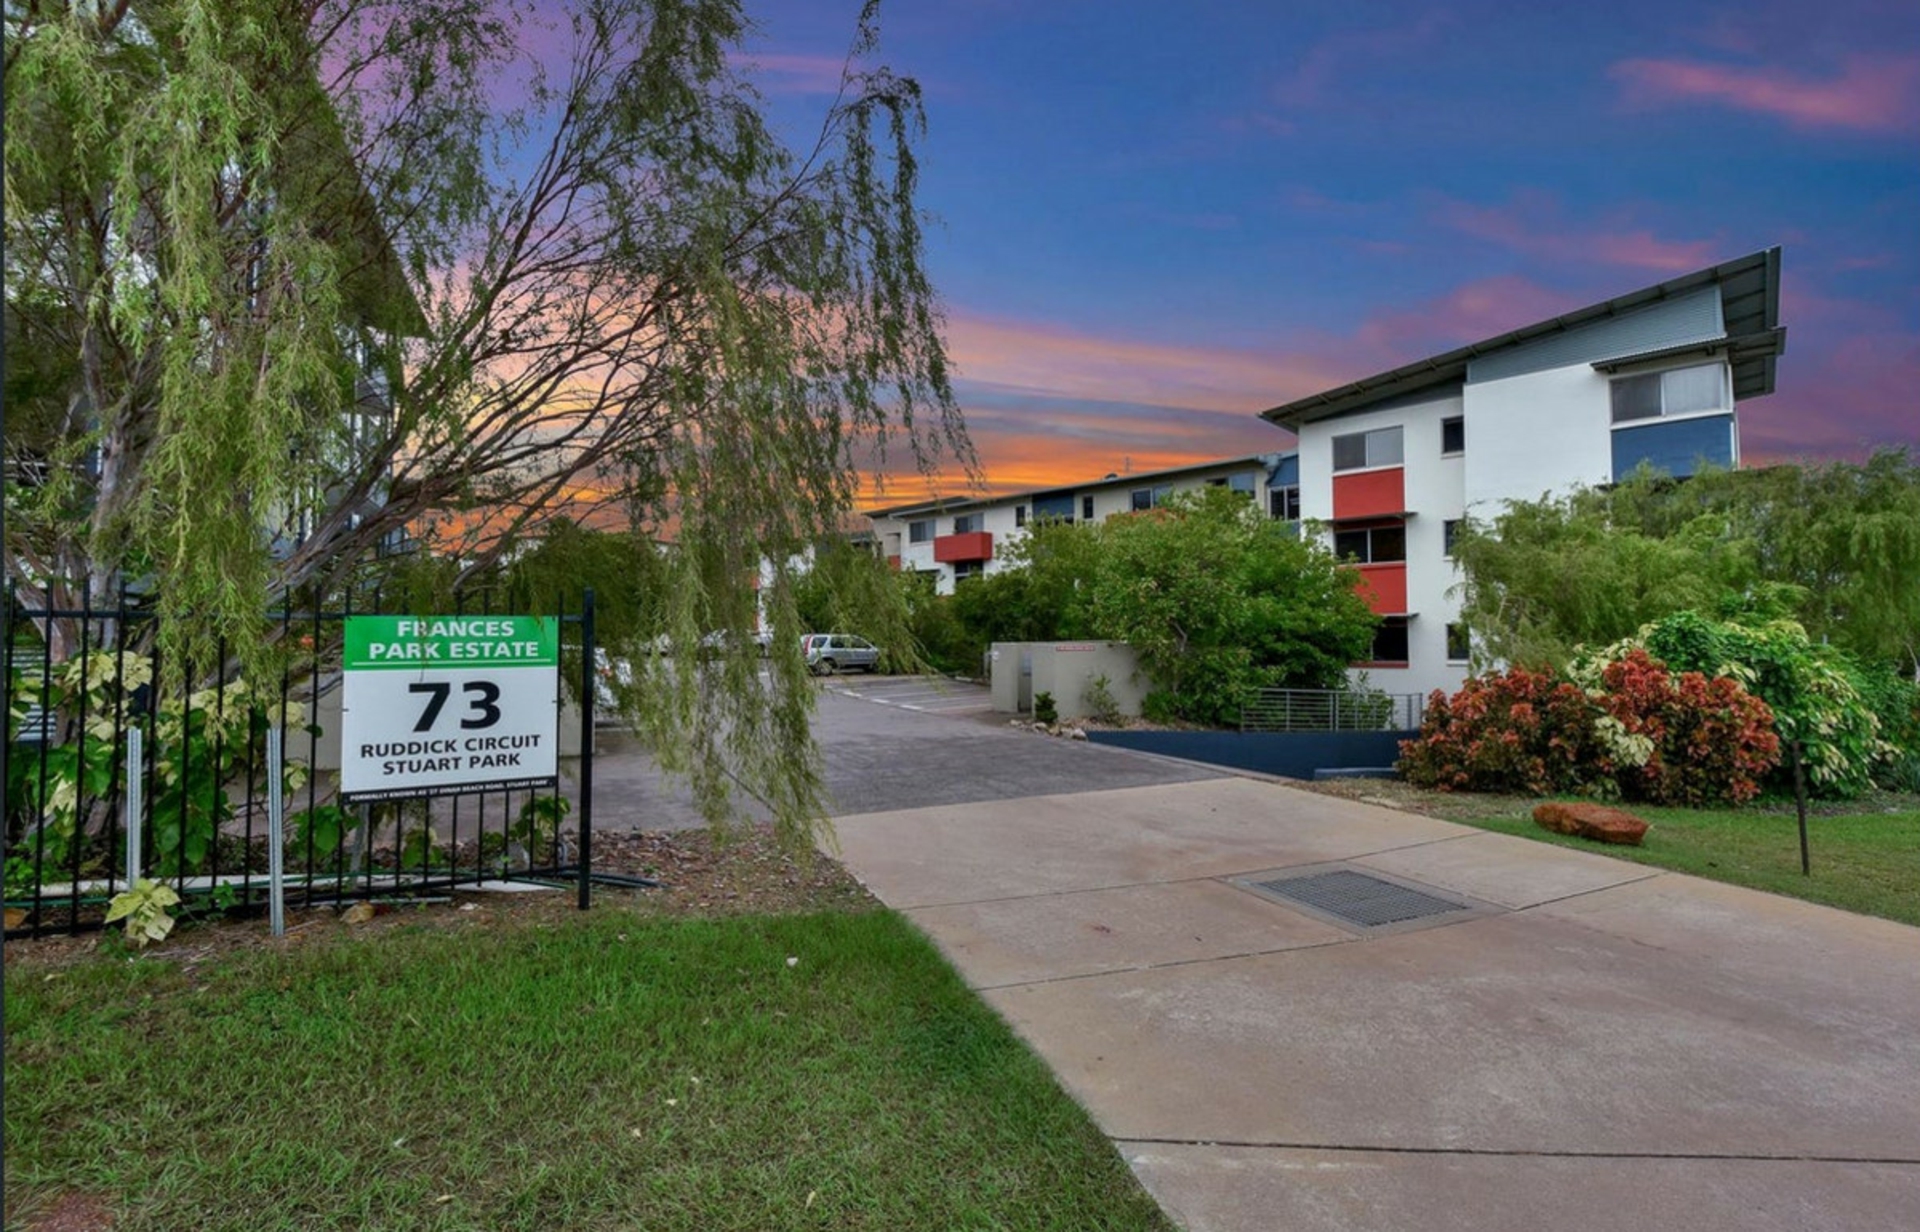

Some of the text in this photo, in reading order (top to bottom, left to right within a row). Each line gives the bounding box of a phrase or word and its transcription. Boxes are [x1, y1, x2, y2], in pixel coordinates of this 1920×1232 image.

[397, 620, 515, 637] FRANCES
[369, 641, 539, 659] PARK ESTATE
[408, 681, 502, 733] 73
[361, 734, 541, 758] RUDDICK CIRCUIT
[383, 753, 521, 775] STUART PARK
